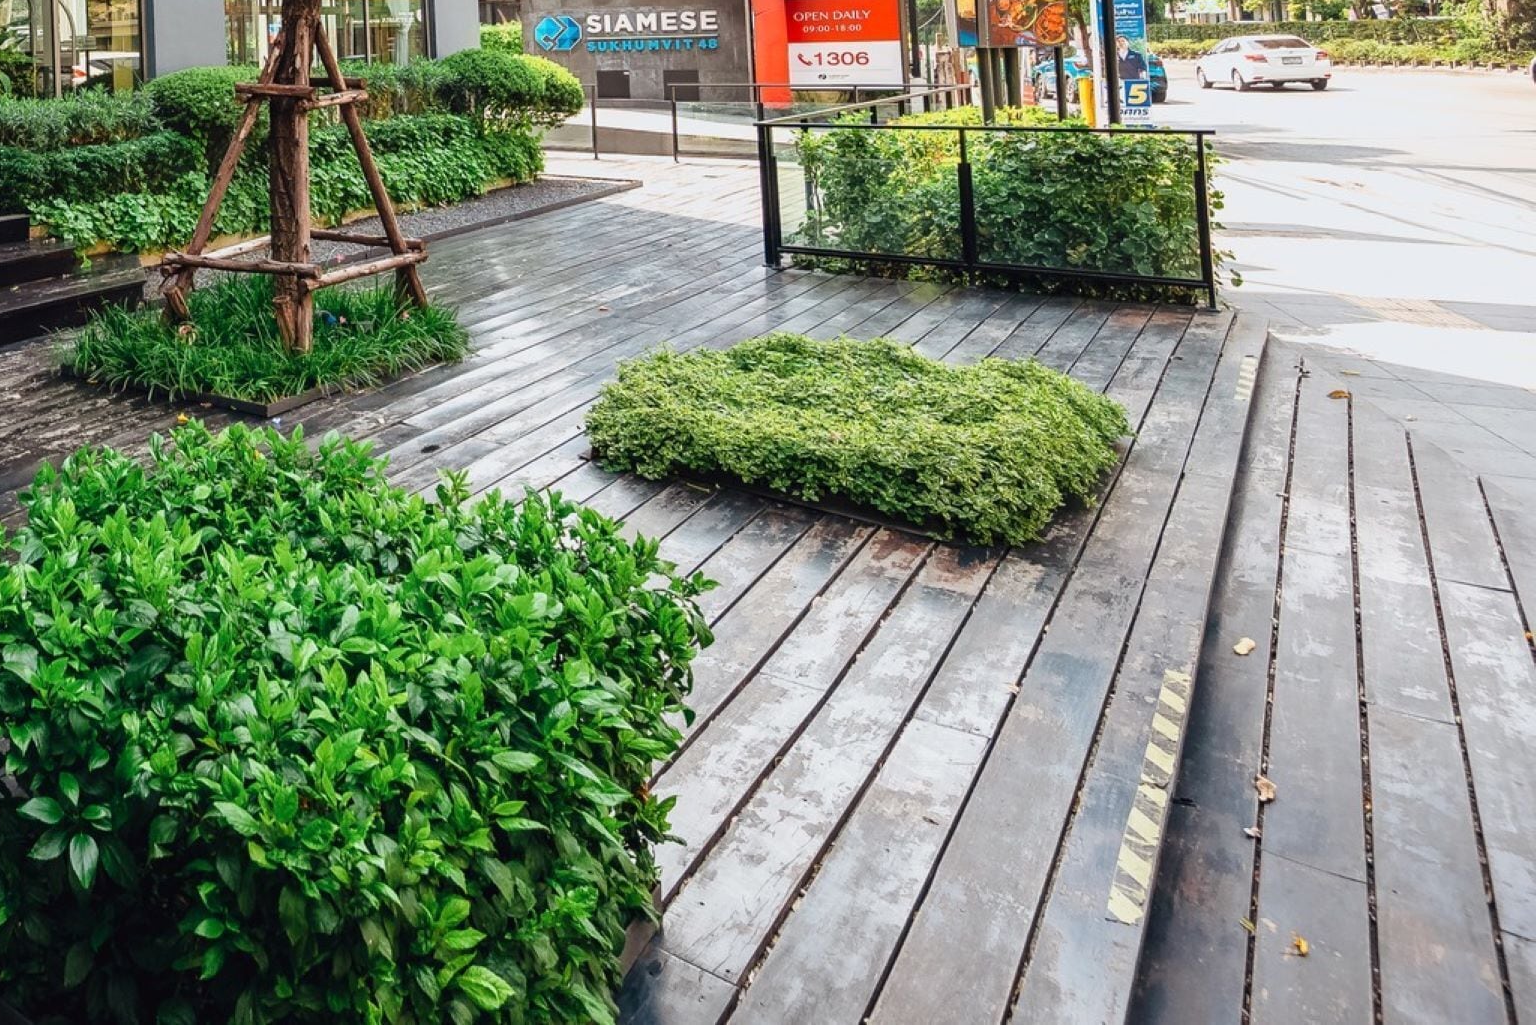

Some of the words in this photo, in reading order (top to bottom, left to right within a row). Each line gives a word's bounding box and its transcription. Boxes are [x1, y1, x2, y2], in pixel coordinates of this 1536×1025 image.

[586, 10, 718, 34] SIAMESE
[793, 11, 829, 22] OPEN
[833, 9, 871, 21] DAILY
[586, 38, 693, 52] SUKHUMVIT
[698, 37, 719, 50] 48
[813, 51, 869, 66] 1306
[1127, 83, 1148, 105] 5
